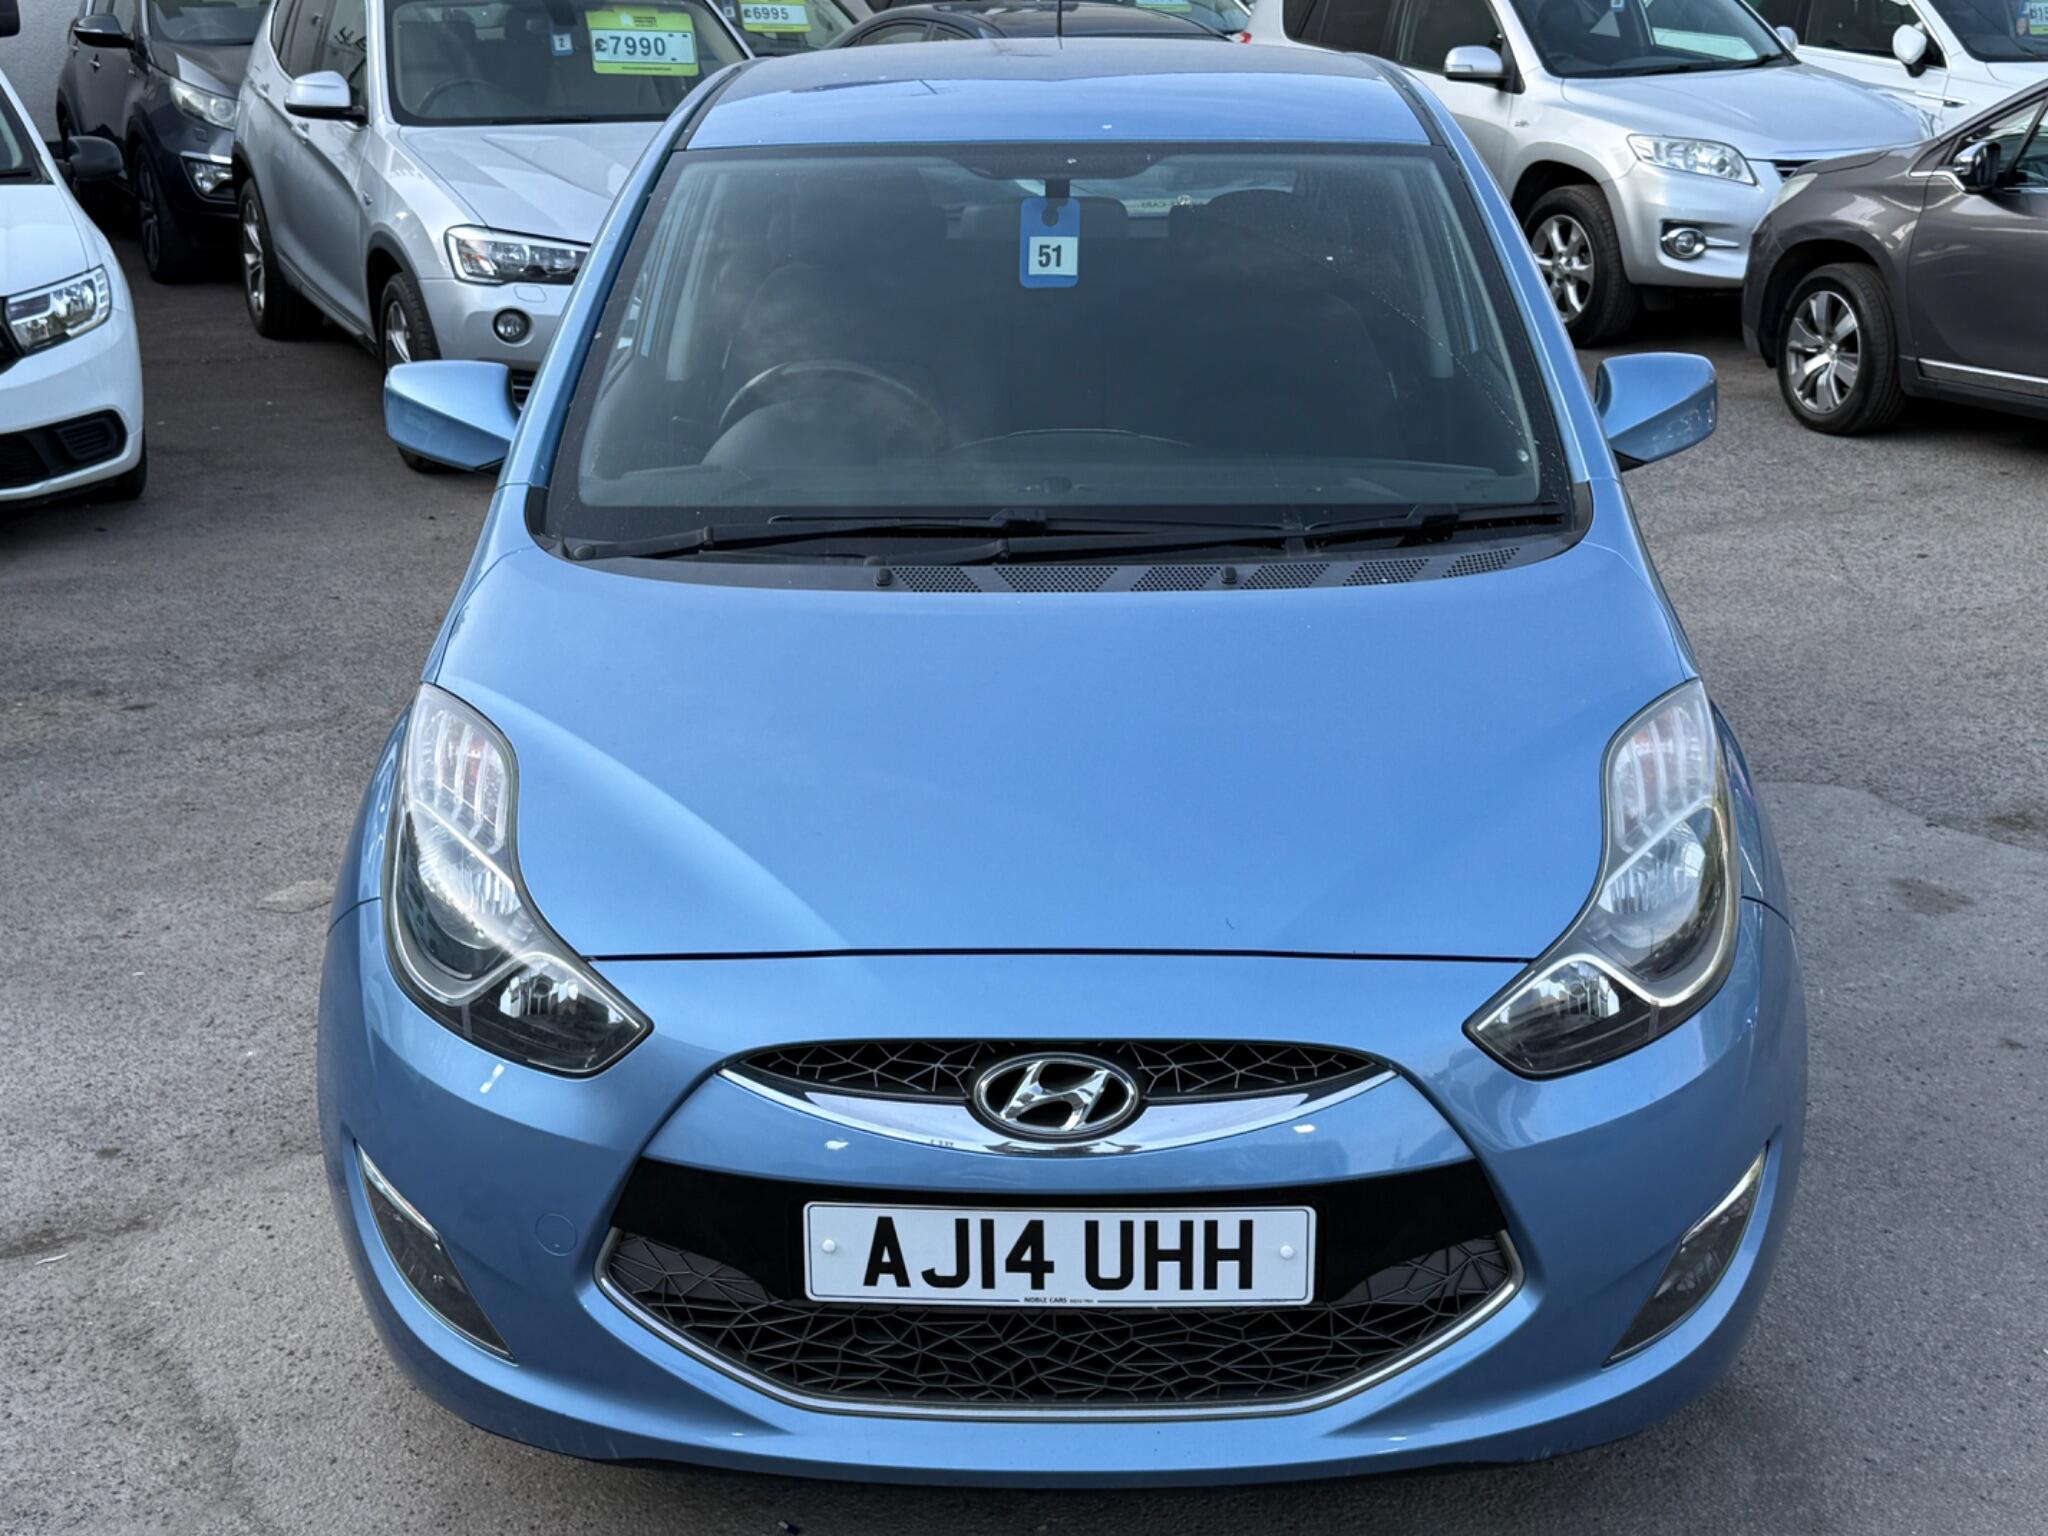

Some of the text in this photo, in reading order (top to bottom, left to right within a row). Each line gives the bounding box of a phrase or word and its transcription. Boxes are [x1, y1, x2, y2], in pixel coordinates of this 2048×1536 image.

[743, 6, 790, 21] £6995
[594, 35, 667, 57] £7990
[1037, 243, 1063, 268] 51
[862, 1214, 1255, 1292] AJ14 UHH
[1048, 1296, 1068, 1304] CARS
